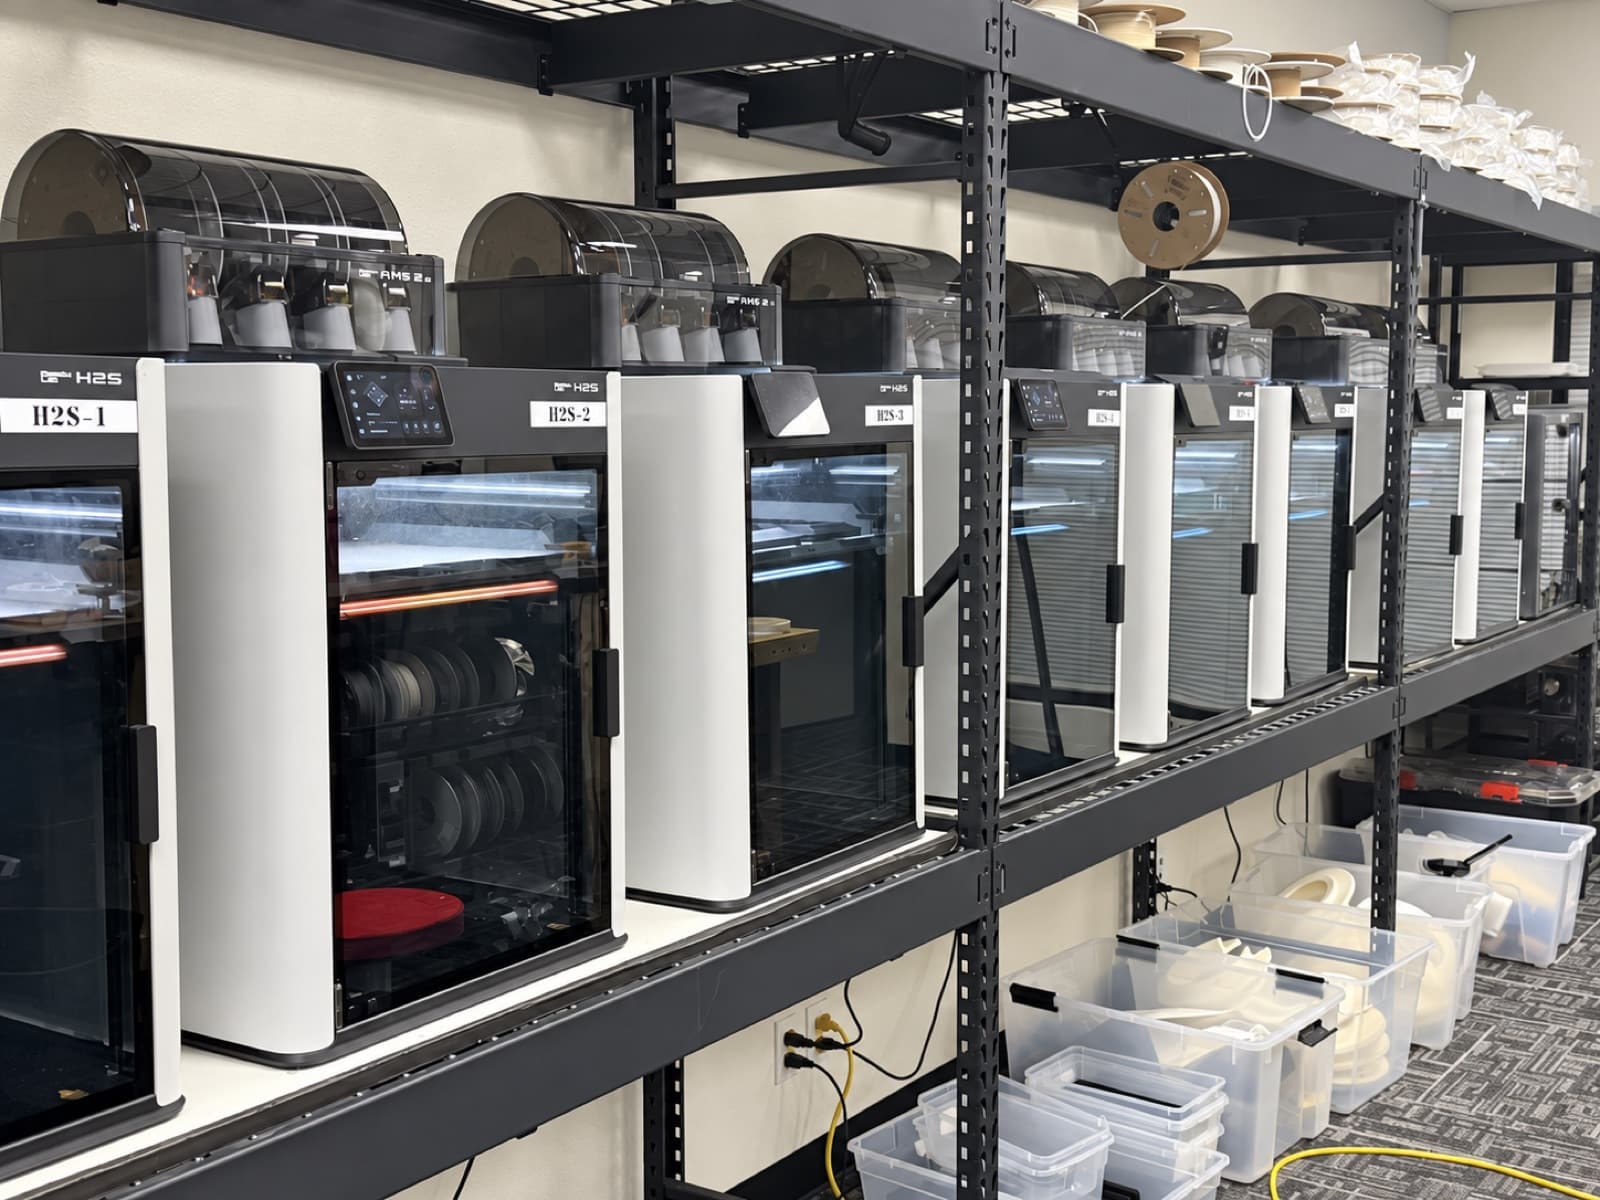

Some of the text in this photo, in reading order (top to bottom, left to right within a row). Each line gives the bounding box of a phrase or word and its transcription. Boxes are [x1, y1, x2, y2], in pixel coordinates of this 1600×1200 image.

[380, 270, 411, 281] AMS
[413, 272, 423, 283] 2
[76, 371, 122, 385] H2S
[573, 382, 599, 392] H2S
[33, 405, 105, 427] H2S-1
[548, 406, 591, 422] H2S-2
[877, 409, 904, 421] H2S-3
